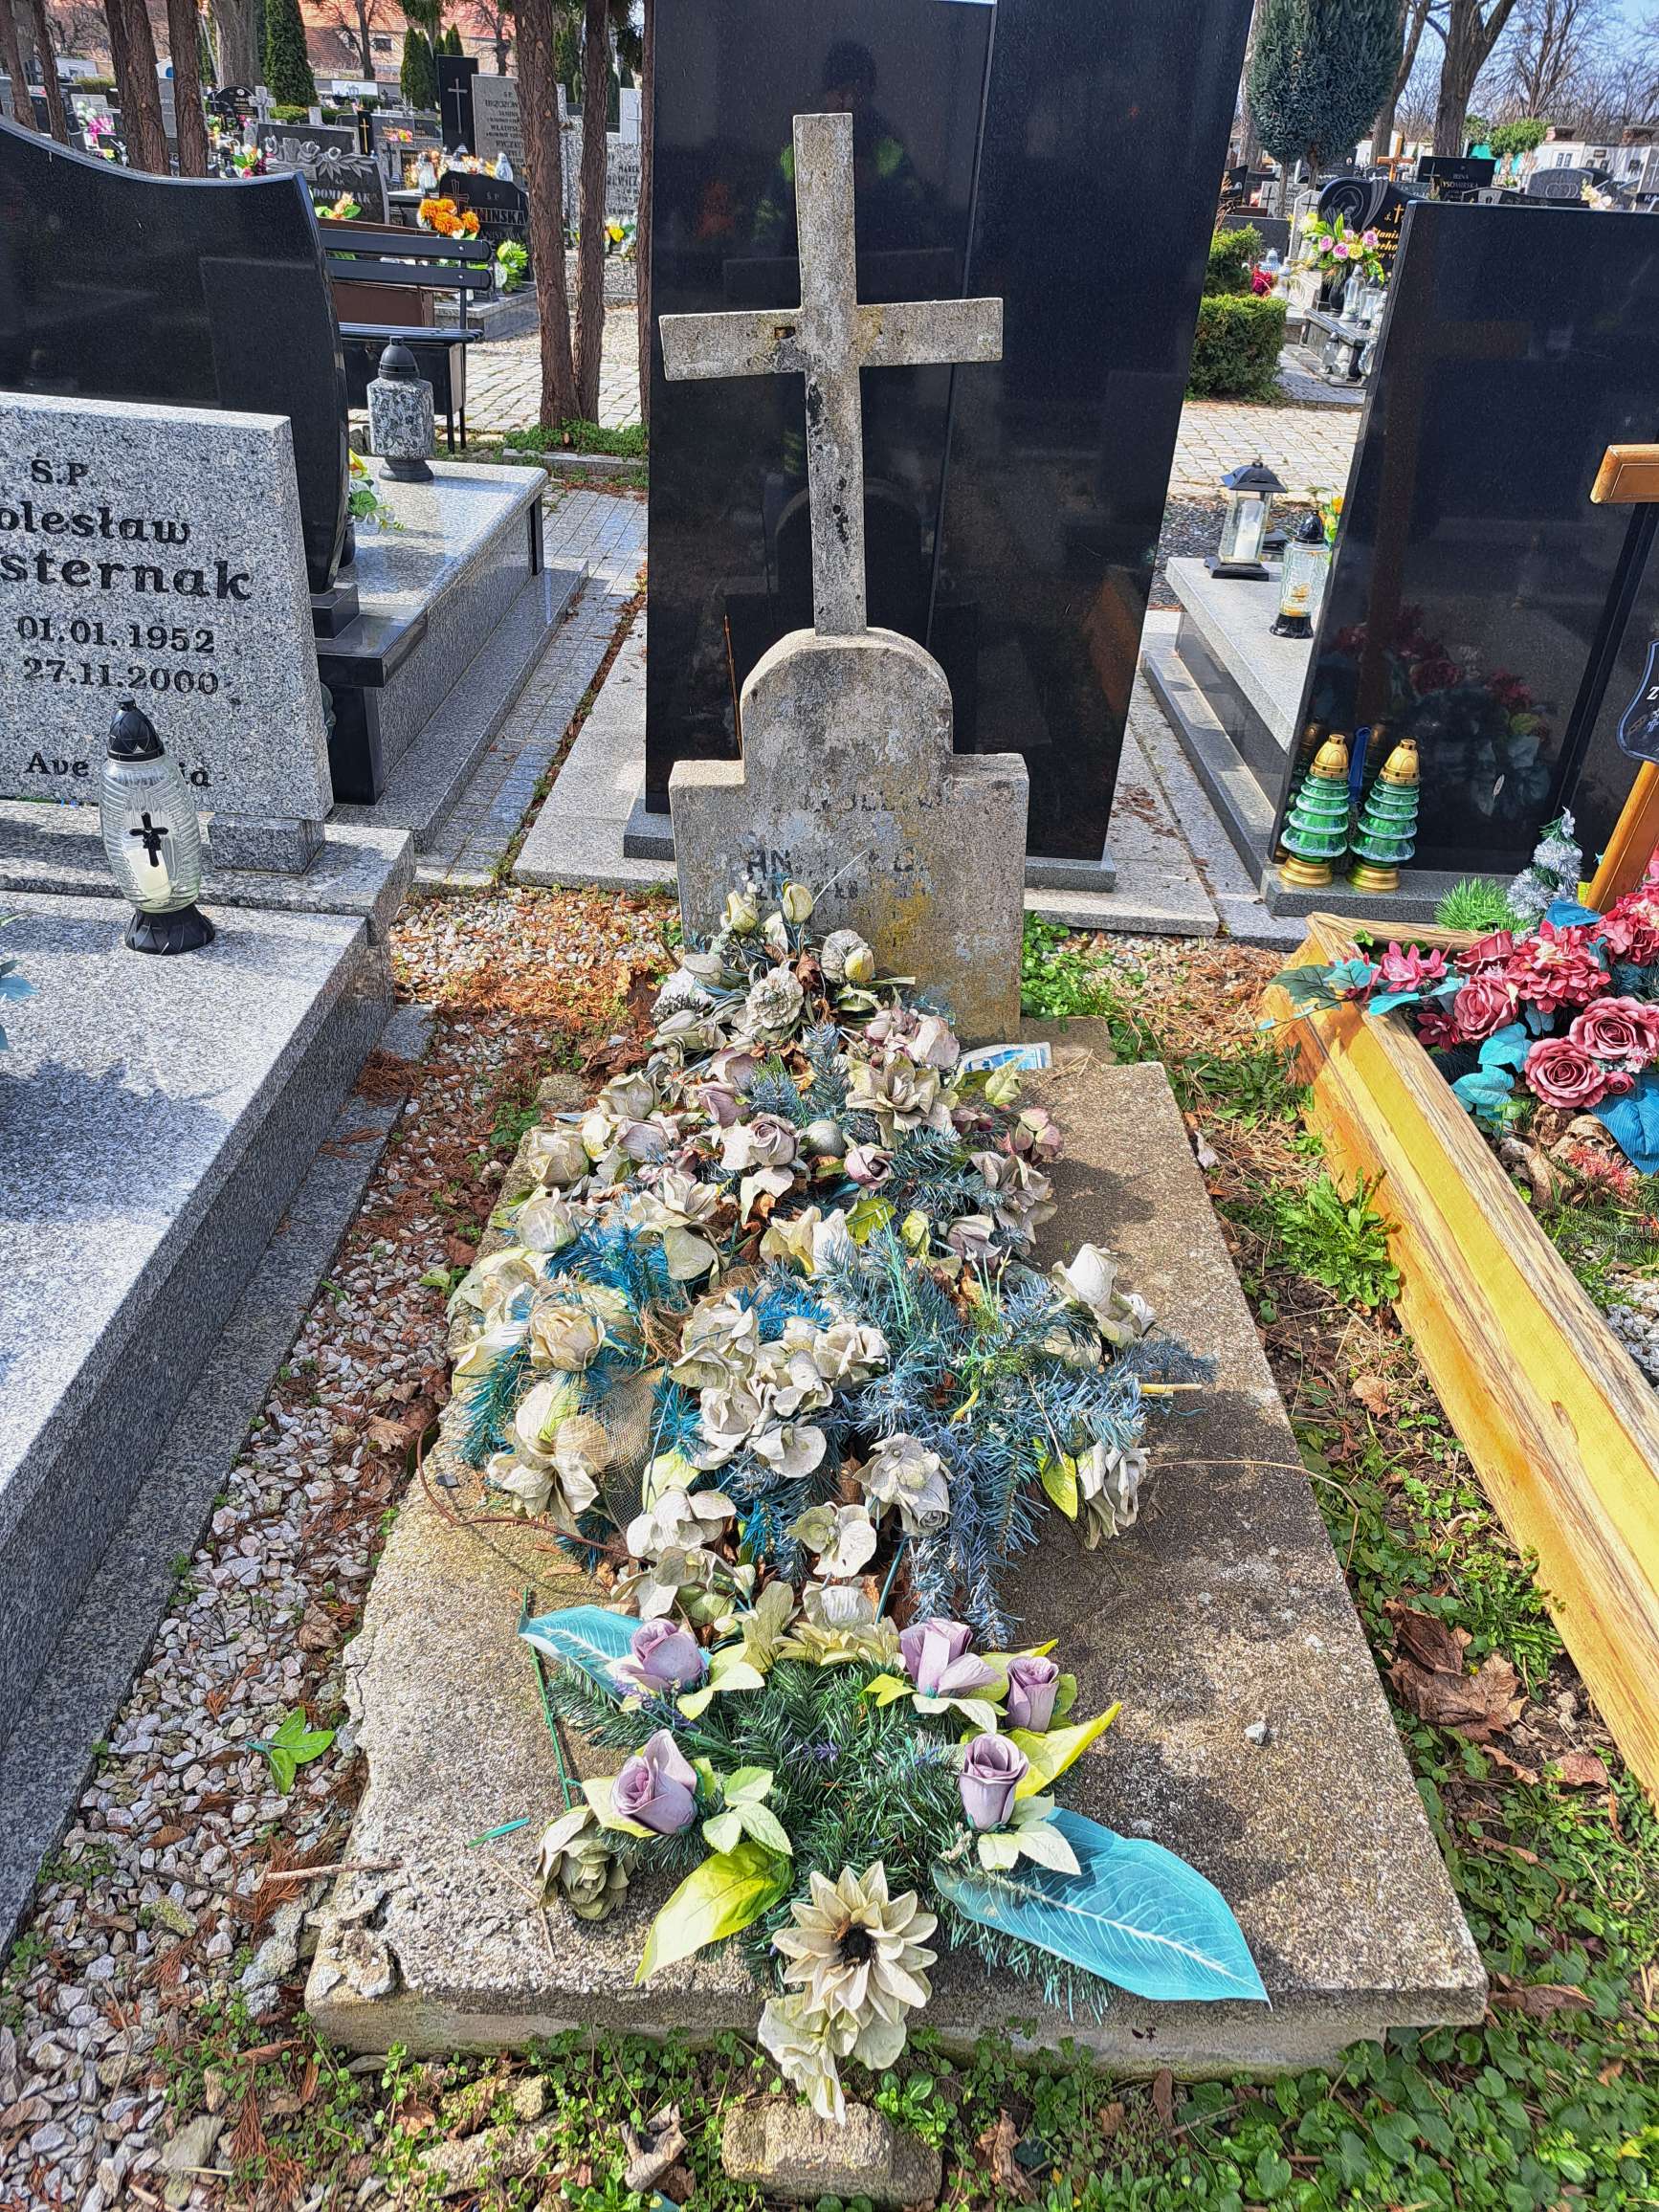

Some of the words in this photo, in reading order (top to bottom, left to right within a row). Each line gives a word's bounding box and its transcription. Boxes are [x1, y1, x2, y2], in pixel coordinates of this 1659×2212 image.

[17, 615, 215, 653] 01.01.1952
[23, 657, 219, 696] 27.11.2000
[24, 750, 90, 778] Ave
